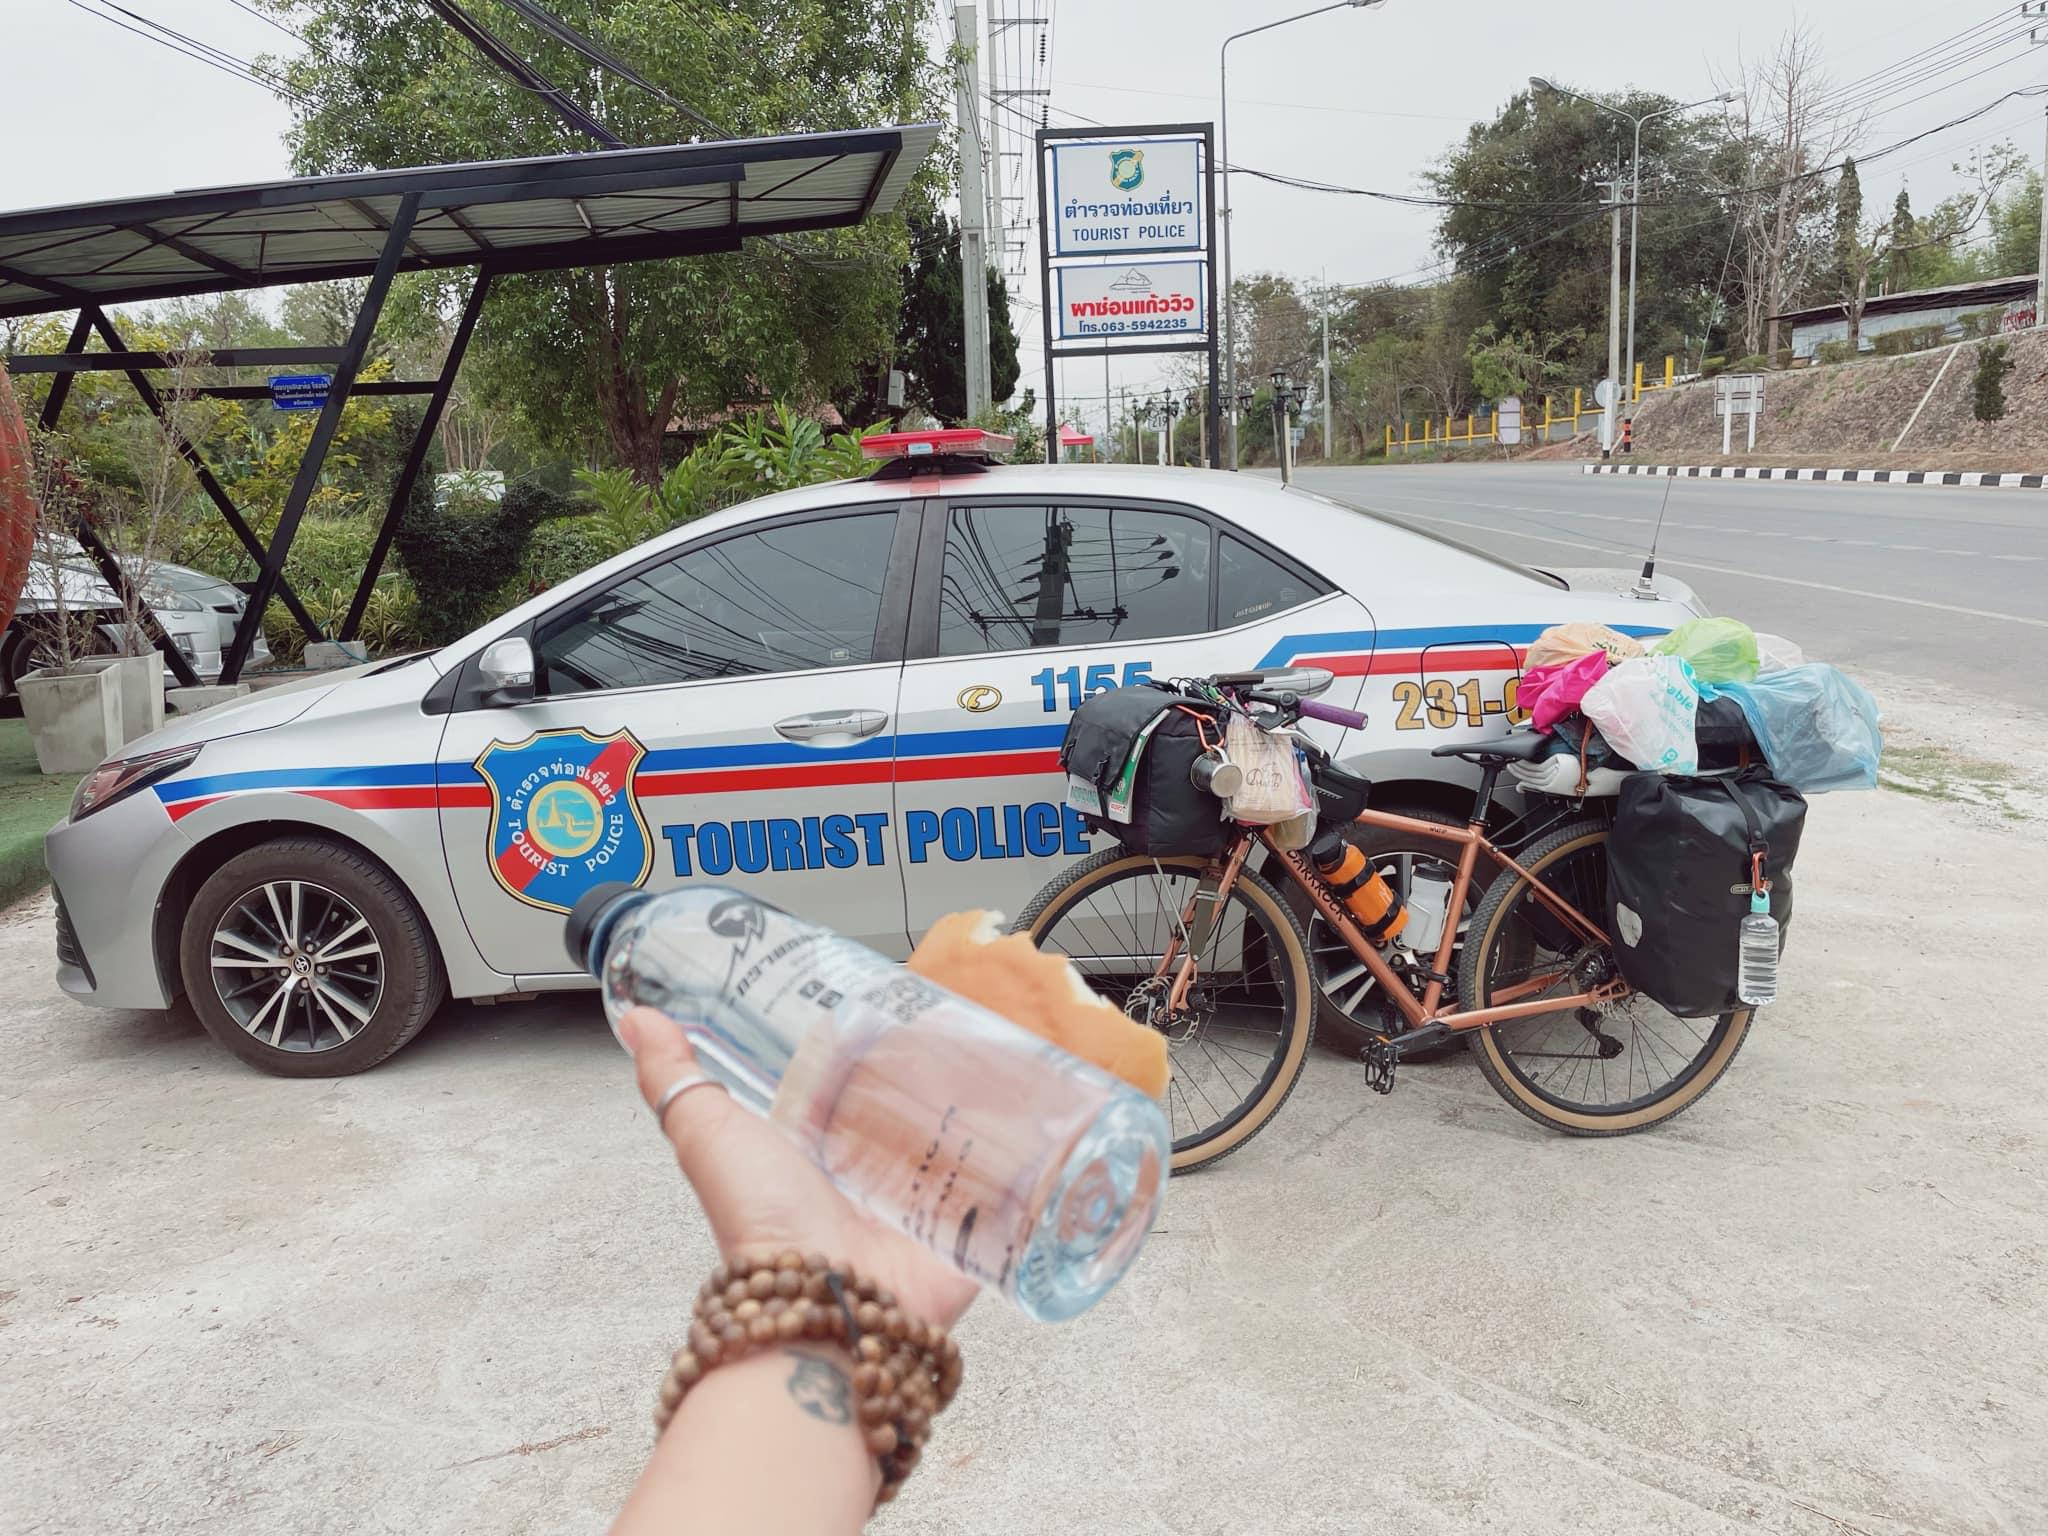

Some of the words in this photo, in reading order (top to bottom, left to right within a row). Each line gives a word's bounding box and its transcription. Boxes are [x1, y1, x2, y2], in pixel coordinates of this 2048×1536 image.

[1065, 190, 1193, 218] ตำรวจท่องเที่ยว
[1072, 227, 1130, 241] TOURIST
[1138, 225, 1185, 239] POLICE
[506, 757, 617, 811] ตำรวจท่องเที่ยว
[508, 818, 569, 877] TOURIST
[584, 813, 624, 873] POLICE
[661, 812, 889, 878] TOURIST
[905, 801, 1091, 864] POLICE
[1286, 849, 1345, 921] DARKROCK
